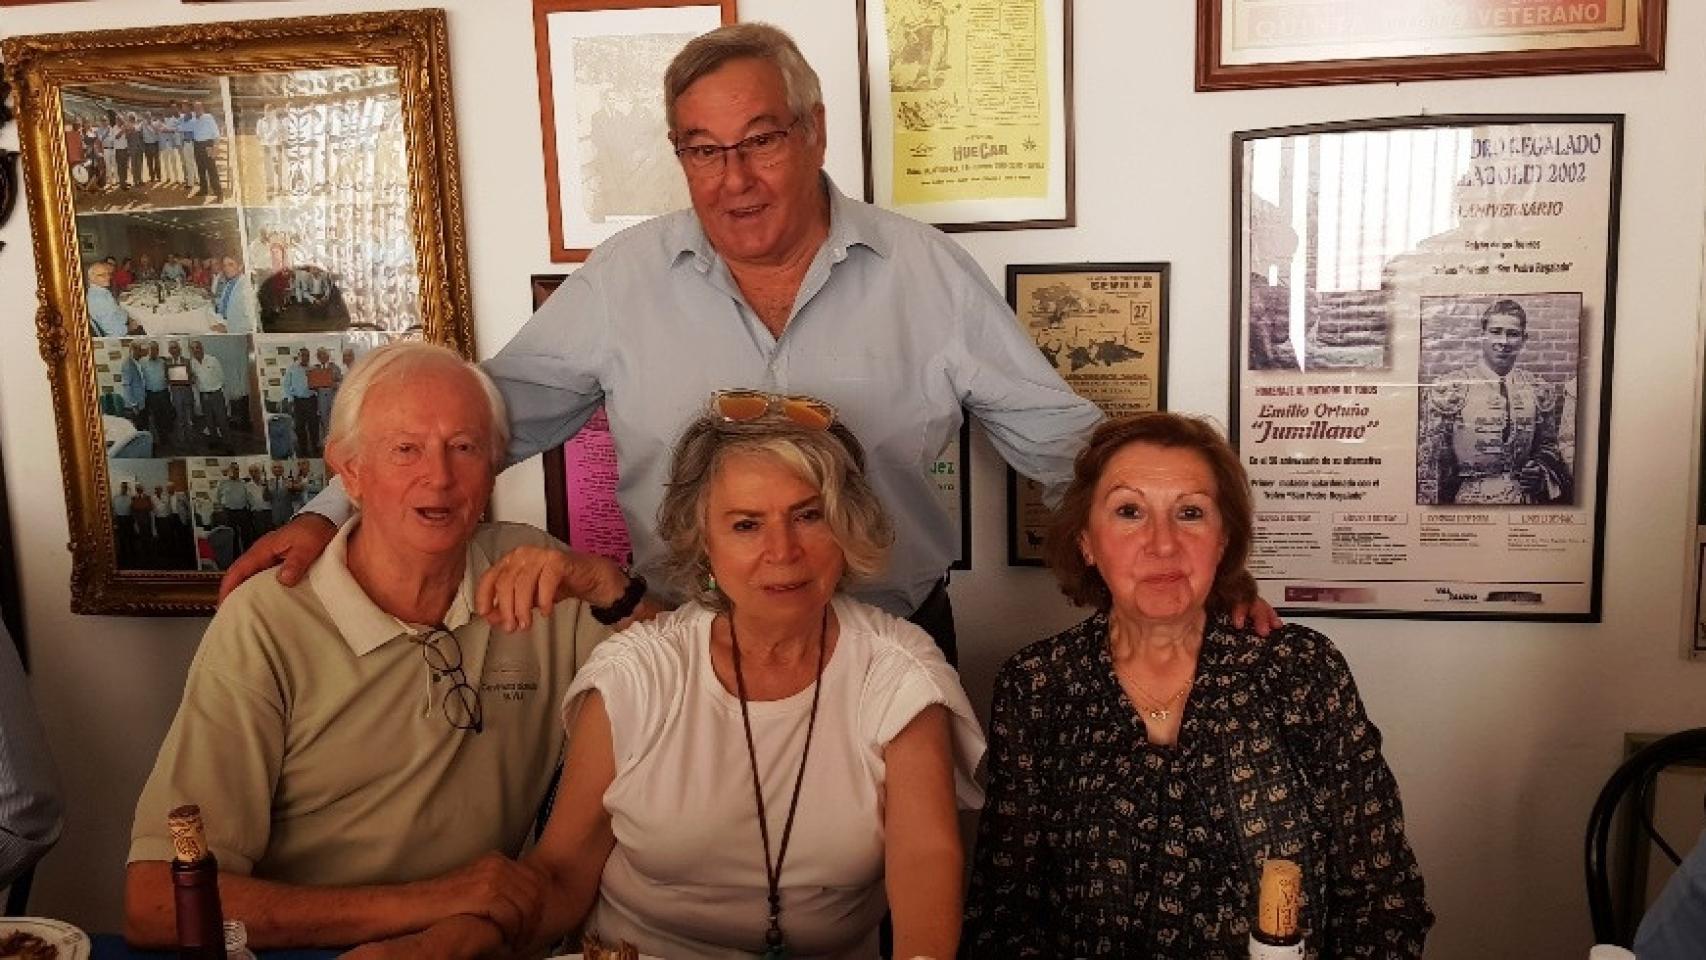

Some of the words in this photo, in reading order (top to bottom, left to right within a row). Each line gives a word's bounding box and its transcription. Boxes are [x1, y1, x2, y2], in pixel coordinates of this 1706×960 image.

[1479, 3, 1601, 26] VETERANO
[1548, 162, 1586, 183] 2002
[1258, 403, 1310, 418] Emilio
[1313, 402, 1370, 418] Ortuño
